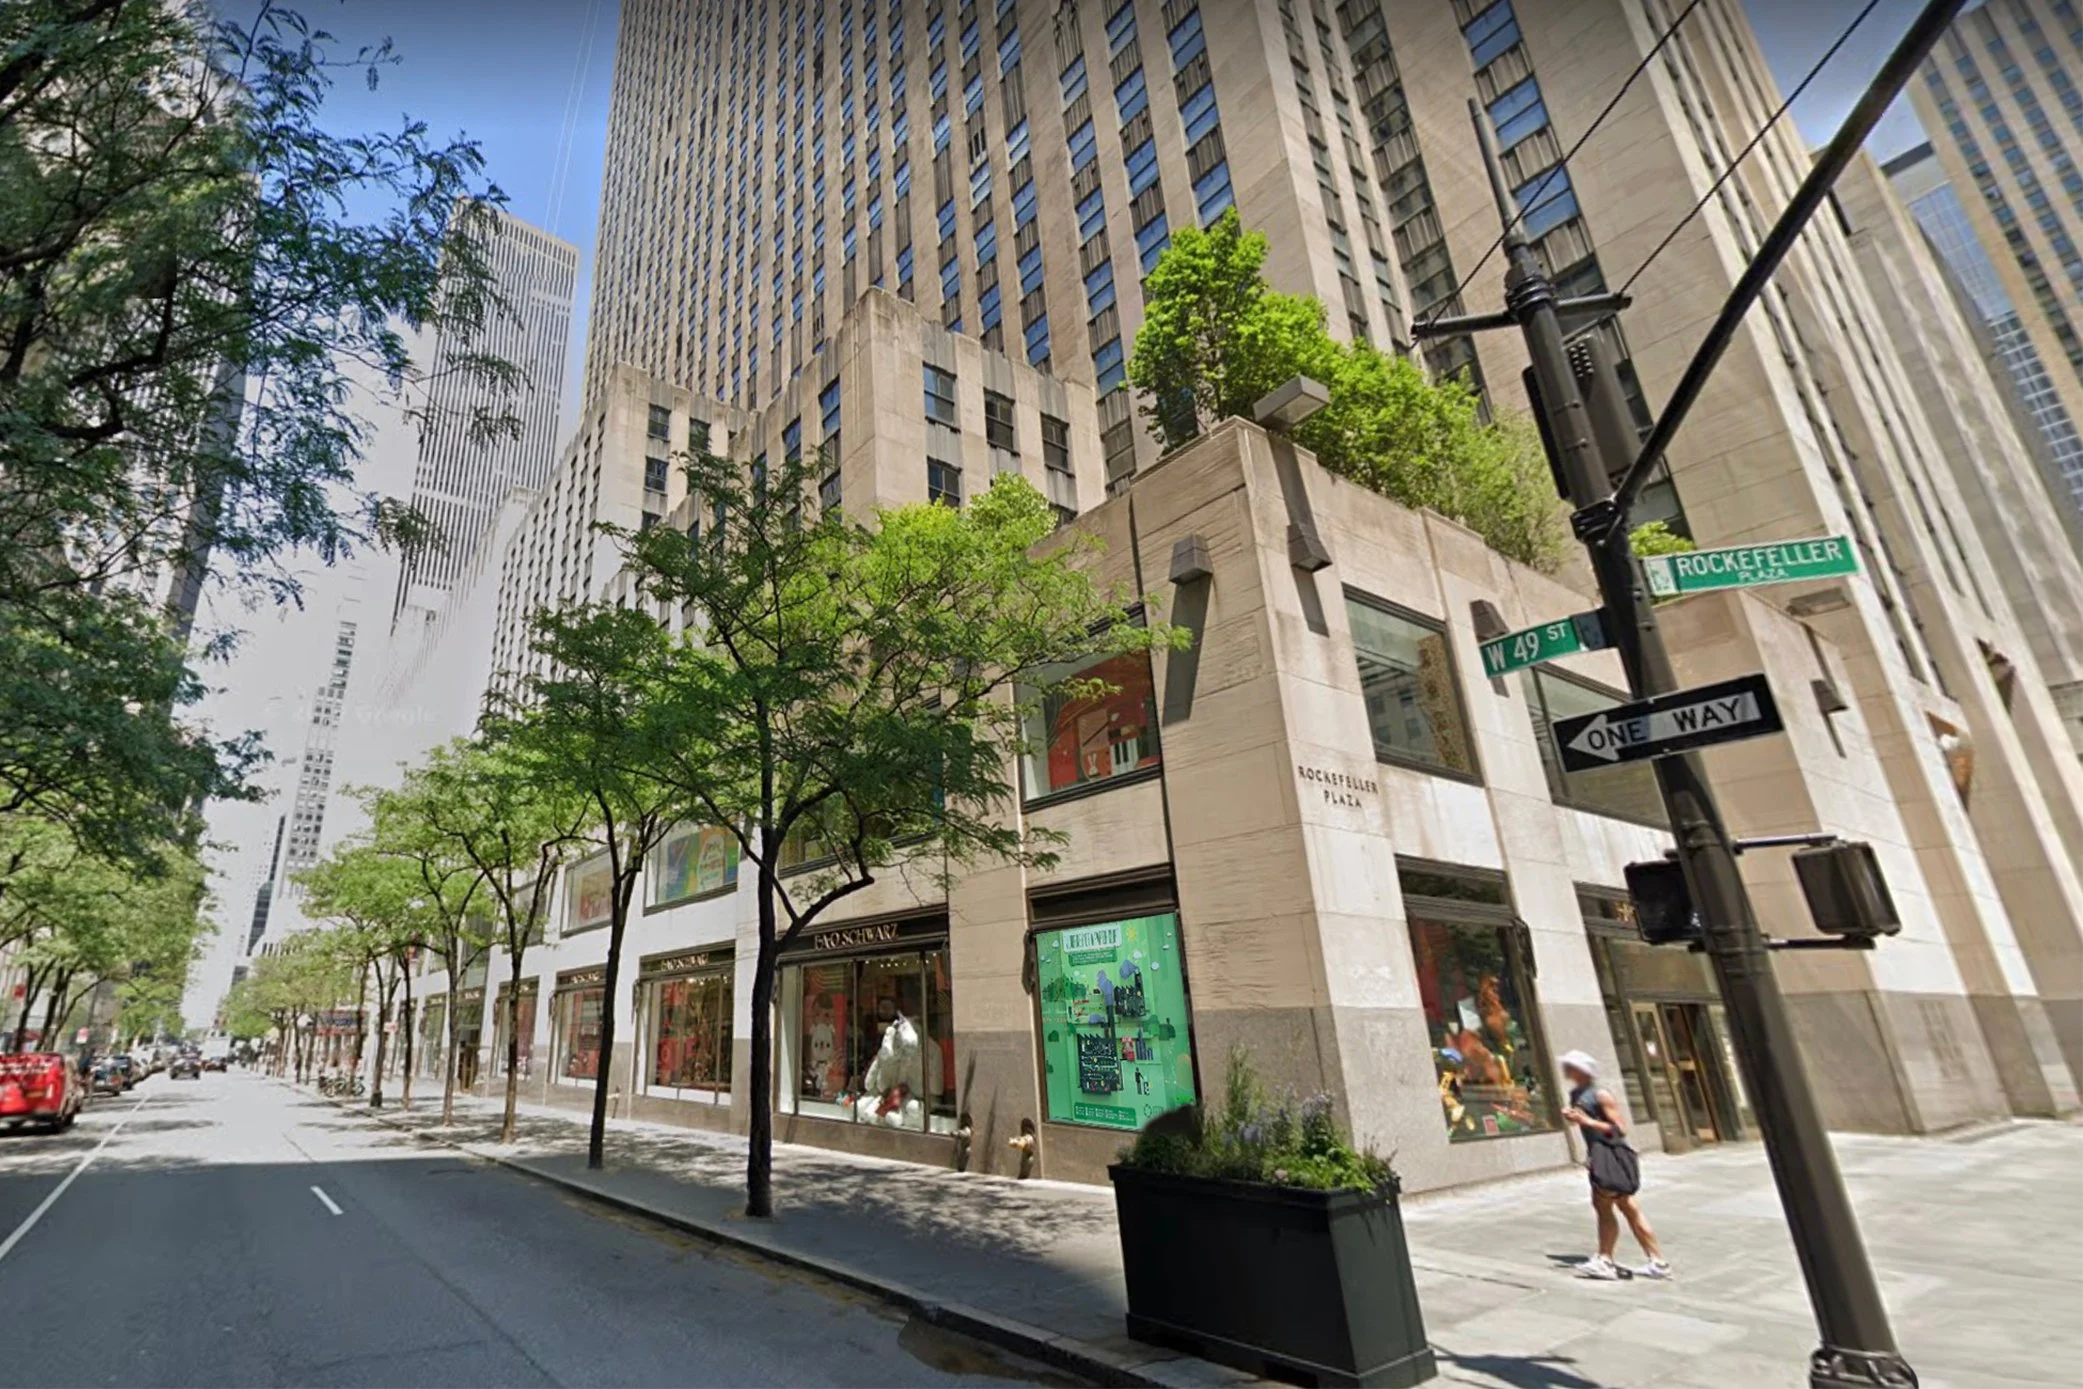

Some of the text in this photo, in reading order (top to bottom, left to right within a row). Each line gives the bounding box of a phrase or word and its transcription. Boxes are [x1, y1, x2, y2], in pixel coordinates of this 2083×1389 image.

[1677, 541, 1842, 577] ROCKEFELLER
[1738, 567, 1788, 582] PLAZA
[1487, 621, 1567, 672] W 49 ST
[1587, 698, 1740, 751] ONE WAY
[1298, 766, 1379, 794] ROCKEFELLER
[1323, 790, 1362, 808] PLAZA
[842, 922, 899, 946] SCHWARZ
